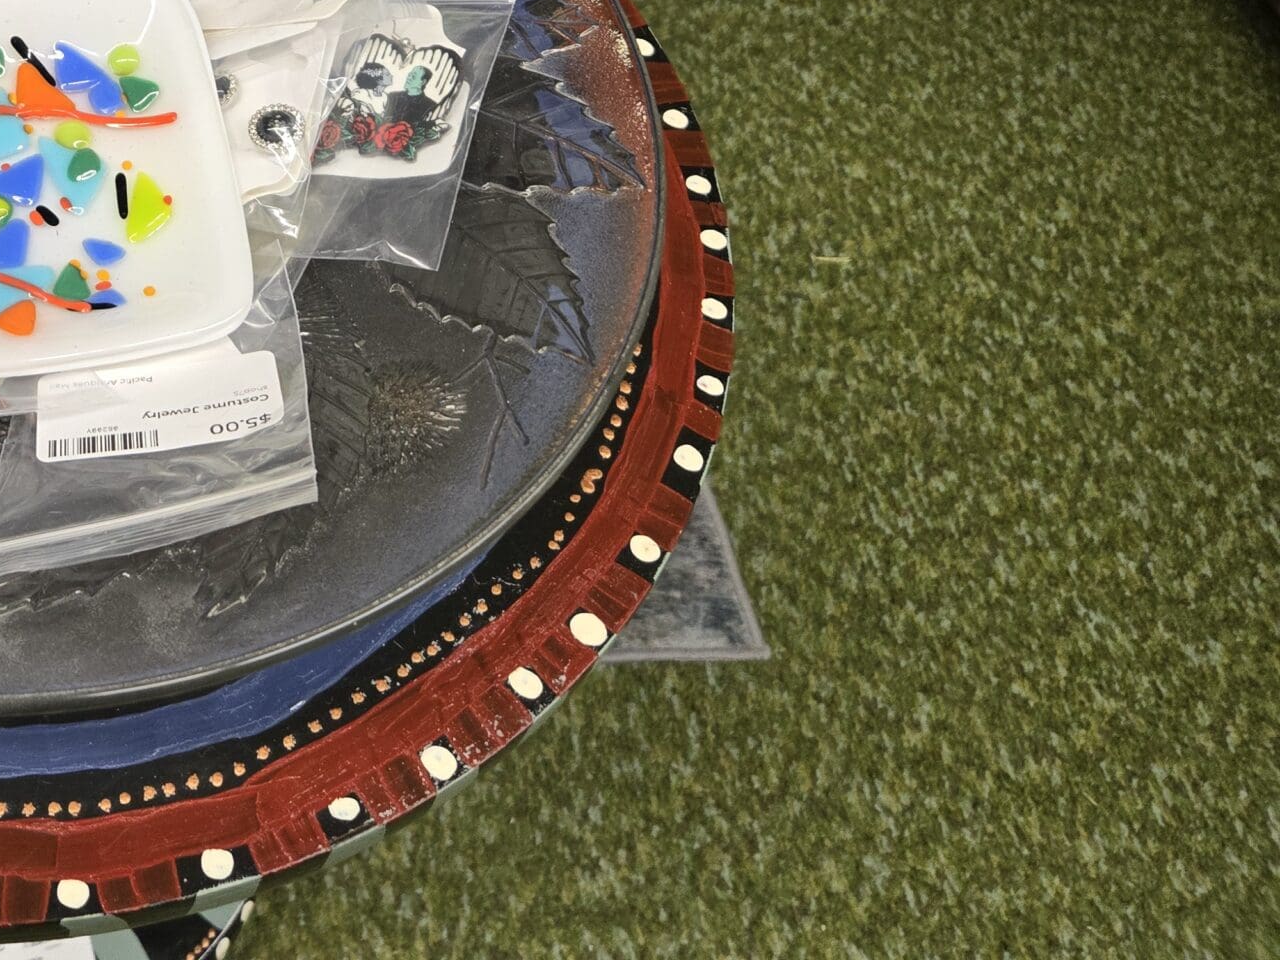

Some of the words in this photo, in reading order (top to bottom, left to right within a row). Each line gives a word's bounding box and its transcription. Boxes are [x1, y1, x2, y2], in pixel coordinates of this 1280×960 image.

[203, 393, 269, 411] Costume
[142, 403, 200, 420] Jewelry
[210, 412, 272, 435] $5.00
